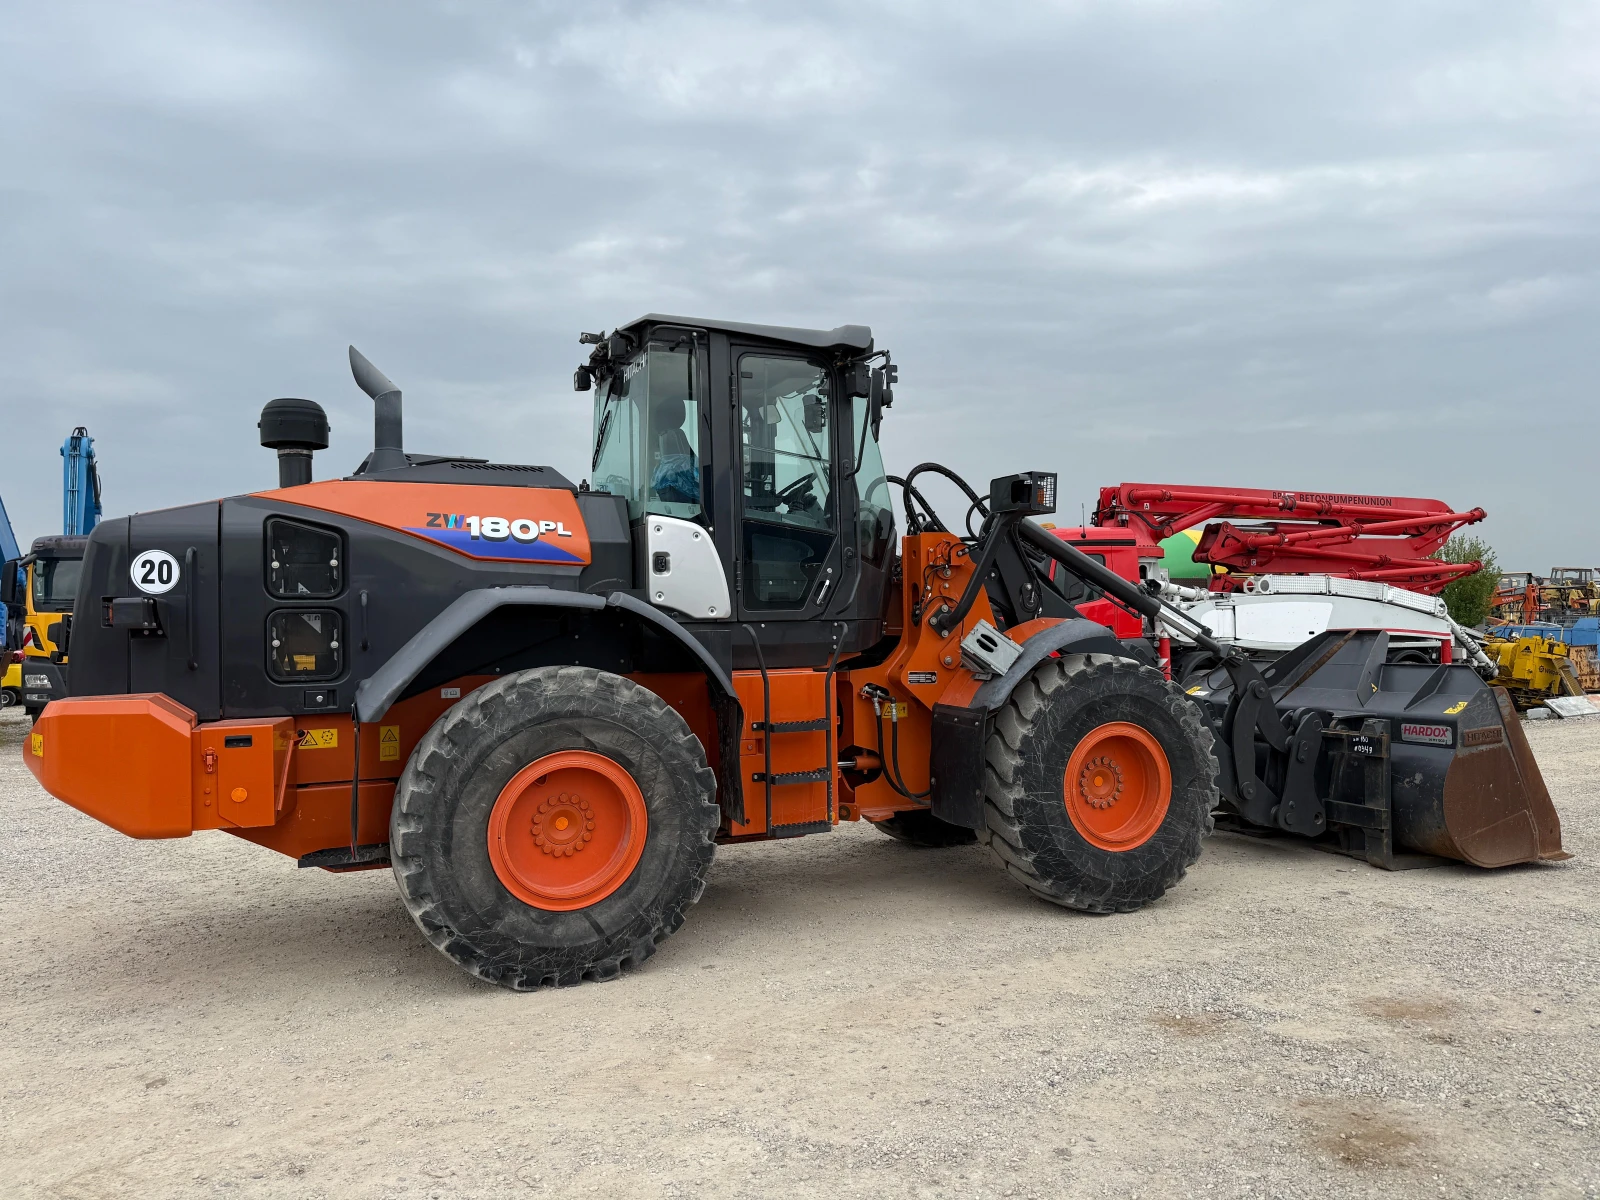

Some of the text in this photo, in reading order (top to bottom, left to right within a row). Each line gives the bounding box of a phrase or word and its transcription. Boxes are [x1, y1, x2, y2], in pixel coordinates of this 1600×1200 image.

[624, 352, 647, 383] HITACHI
[1299, 494, 1392, 506] BETONPUMPENUNION
[140, 559, 173, 585] 20
[1403, 725, 1447, 737] HARDOX
[1467, 730, 1502, 741] HITACHI
